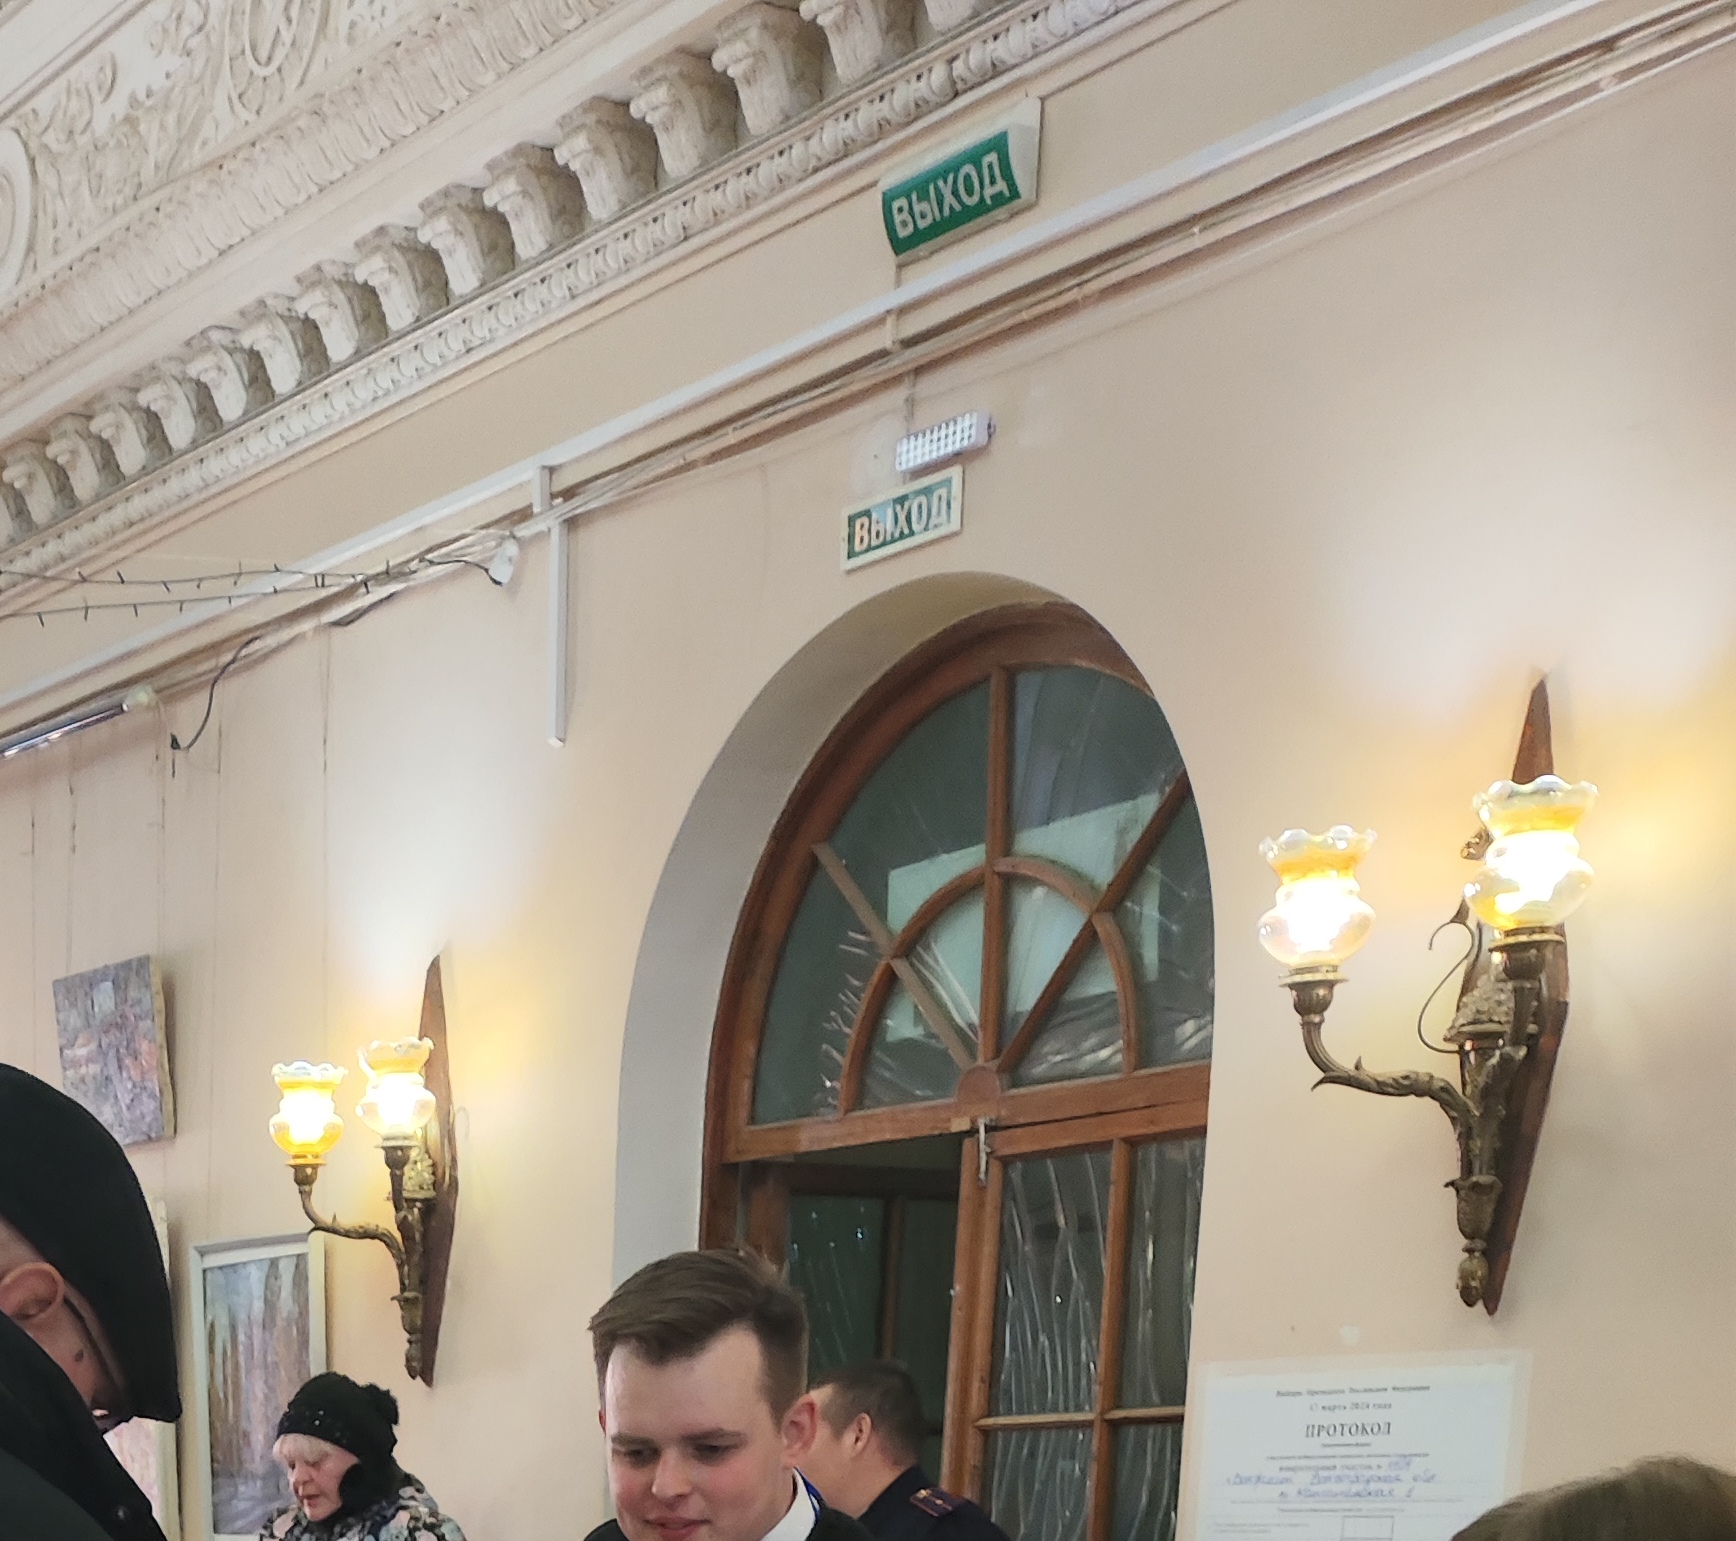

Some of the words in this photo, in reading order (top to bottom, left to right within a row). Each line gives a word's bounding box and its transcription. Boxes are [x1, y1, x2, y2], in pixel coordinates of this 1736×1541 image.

[890, 150, 1011, 239] ВЫХОД
[853, 486, 951, 553] ВЫХОД
[1304, 1421, 1392, 1438] ПРОТОКОЛ
